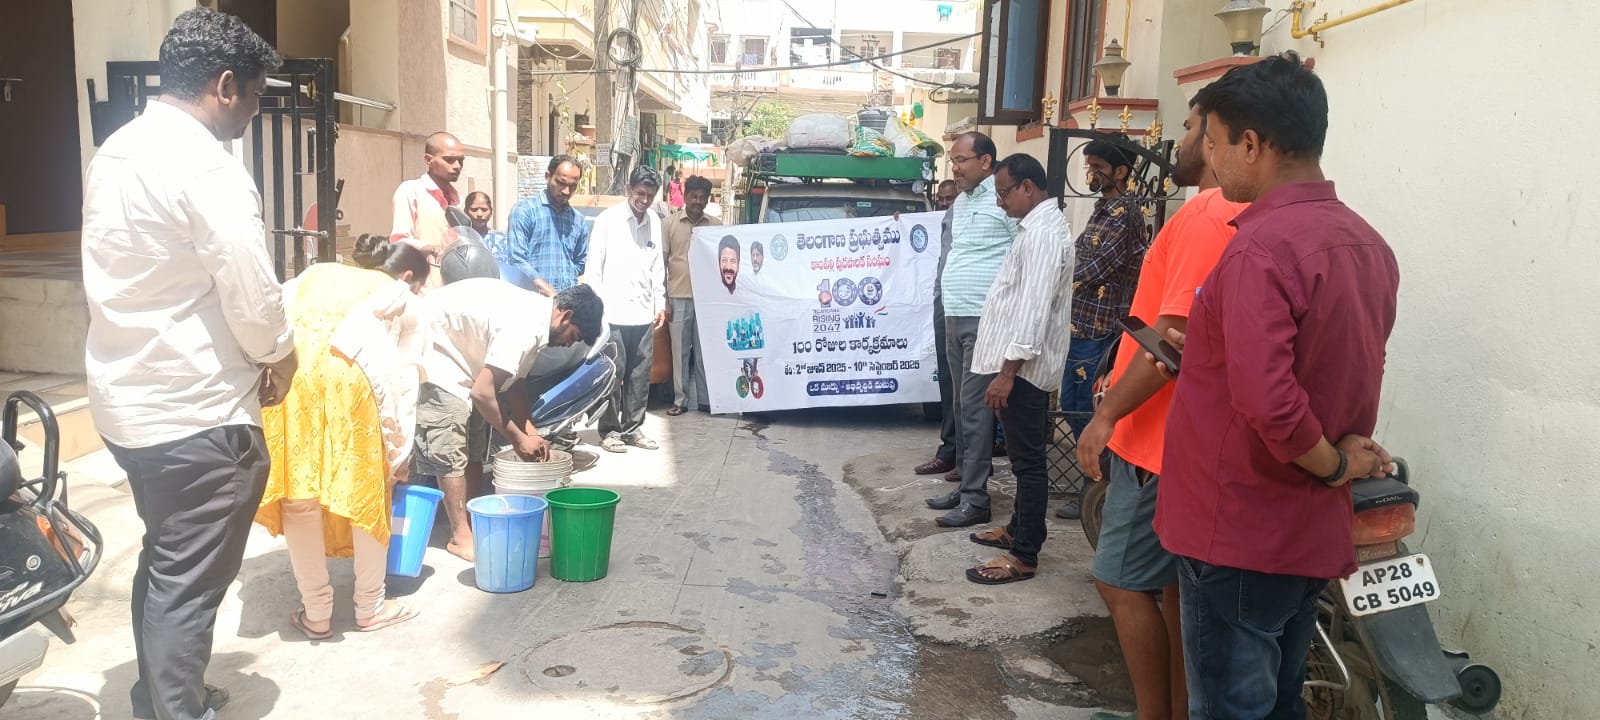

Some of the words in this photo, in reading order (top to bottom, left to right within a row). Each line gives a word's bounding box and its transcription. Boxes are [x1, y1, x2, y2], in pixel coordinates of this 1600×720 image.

[797, 233, 846, 250] తెలంగాణ
[849, 227, 901, 253] ప్రభుత్వము
[812, 314, 840, 323] RISING
[813, 323, 840, 332] 2047
[792, 340, 811, 354] 100
[815, 336, 847, 352] రోజుల
[849, 335, 908, 355] కార్యక్రమాలు
[826, 362, 846, 373] 2025
[899, 359, 920, 370] 2025
[1362, 562, 1412, 587] AP28
[1352, 592, 1382, 612] CB
[1387, 581, 1435, 605] 5049
